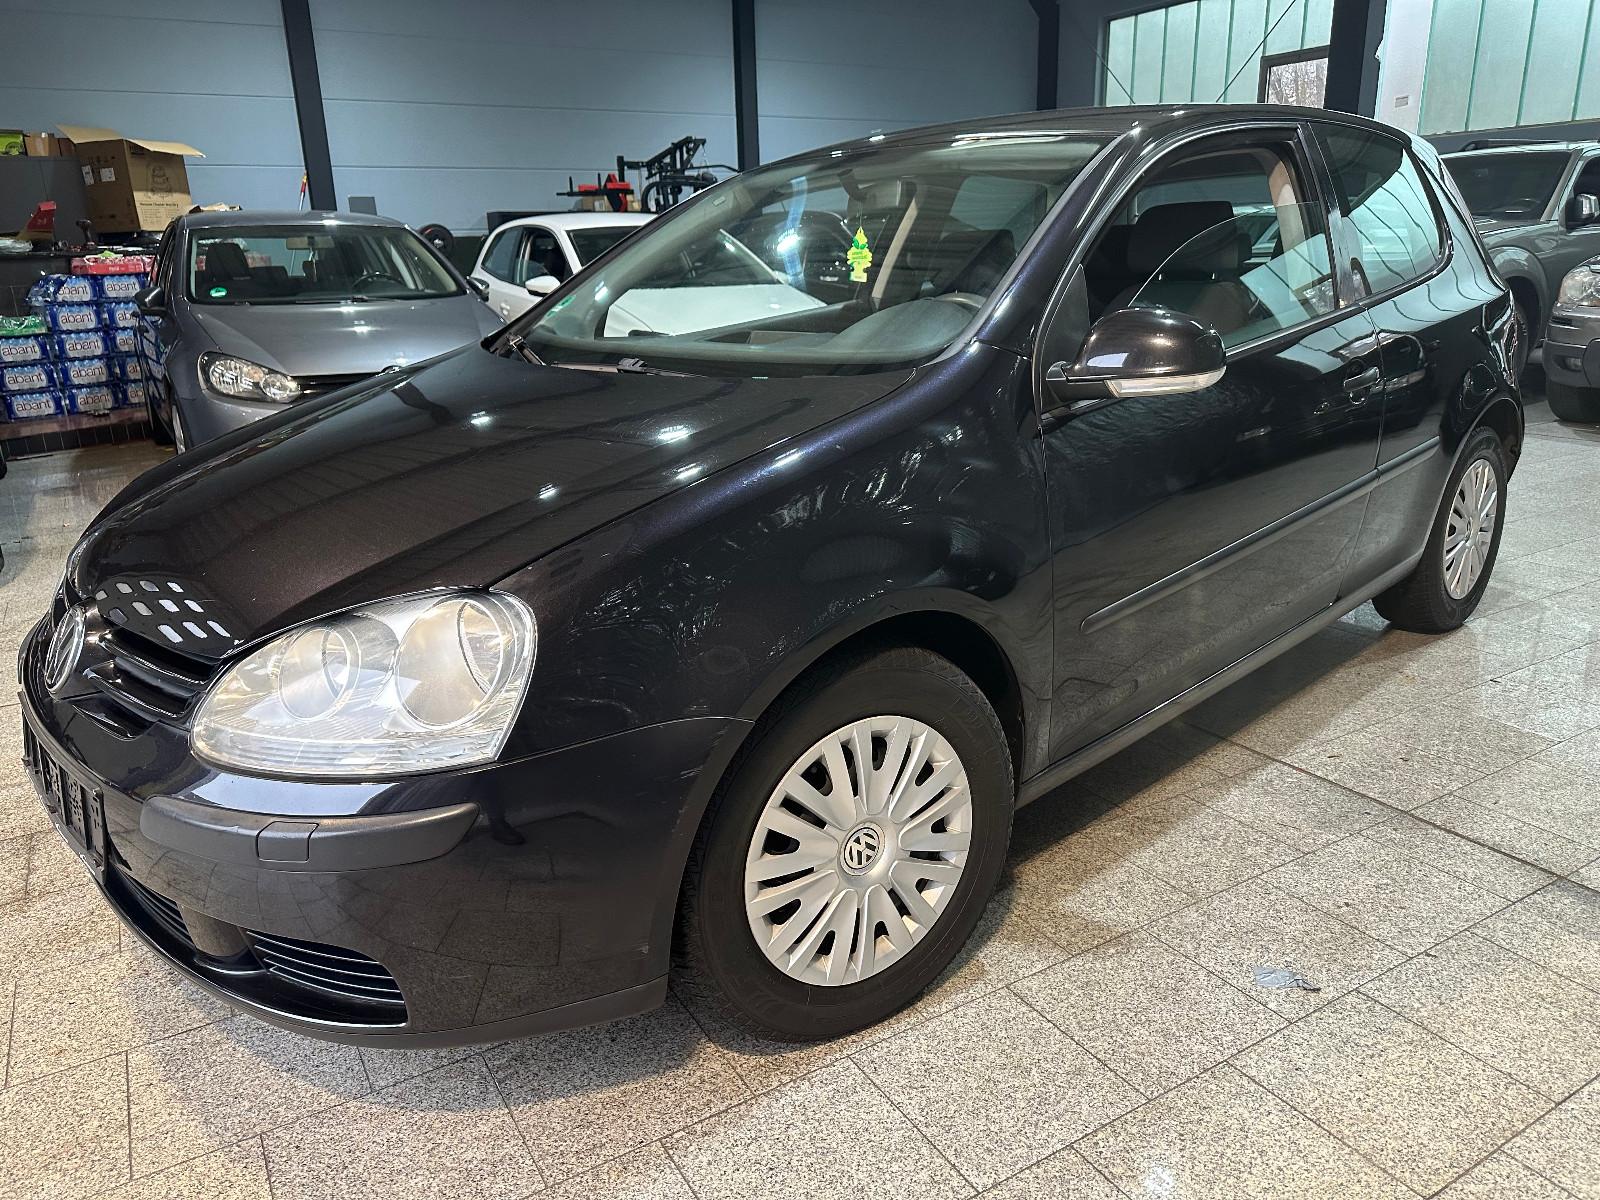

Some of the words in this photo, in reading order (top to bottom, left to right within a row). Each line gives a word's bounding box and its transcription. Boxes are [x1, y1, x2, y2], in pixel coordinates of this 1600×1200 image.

[107, 281, 137, 291] abant
[61, 311, 93, 324] abant
[2, 345, 37, 356] abant
[68, 339, 99, 351] abant
[8, 372, 43, 384] abant
[72, 366, 104, 378] abant
[79, 393, 109, 405] abant
[16, 400, 51, 411] abant
